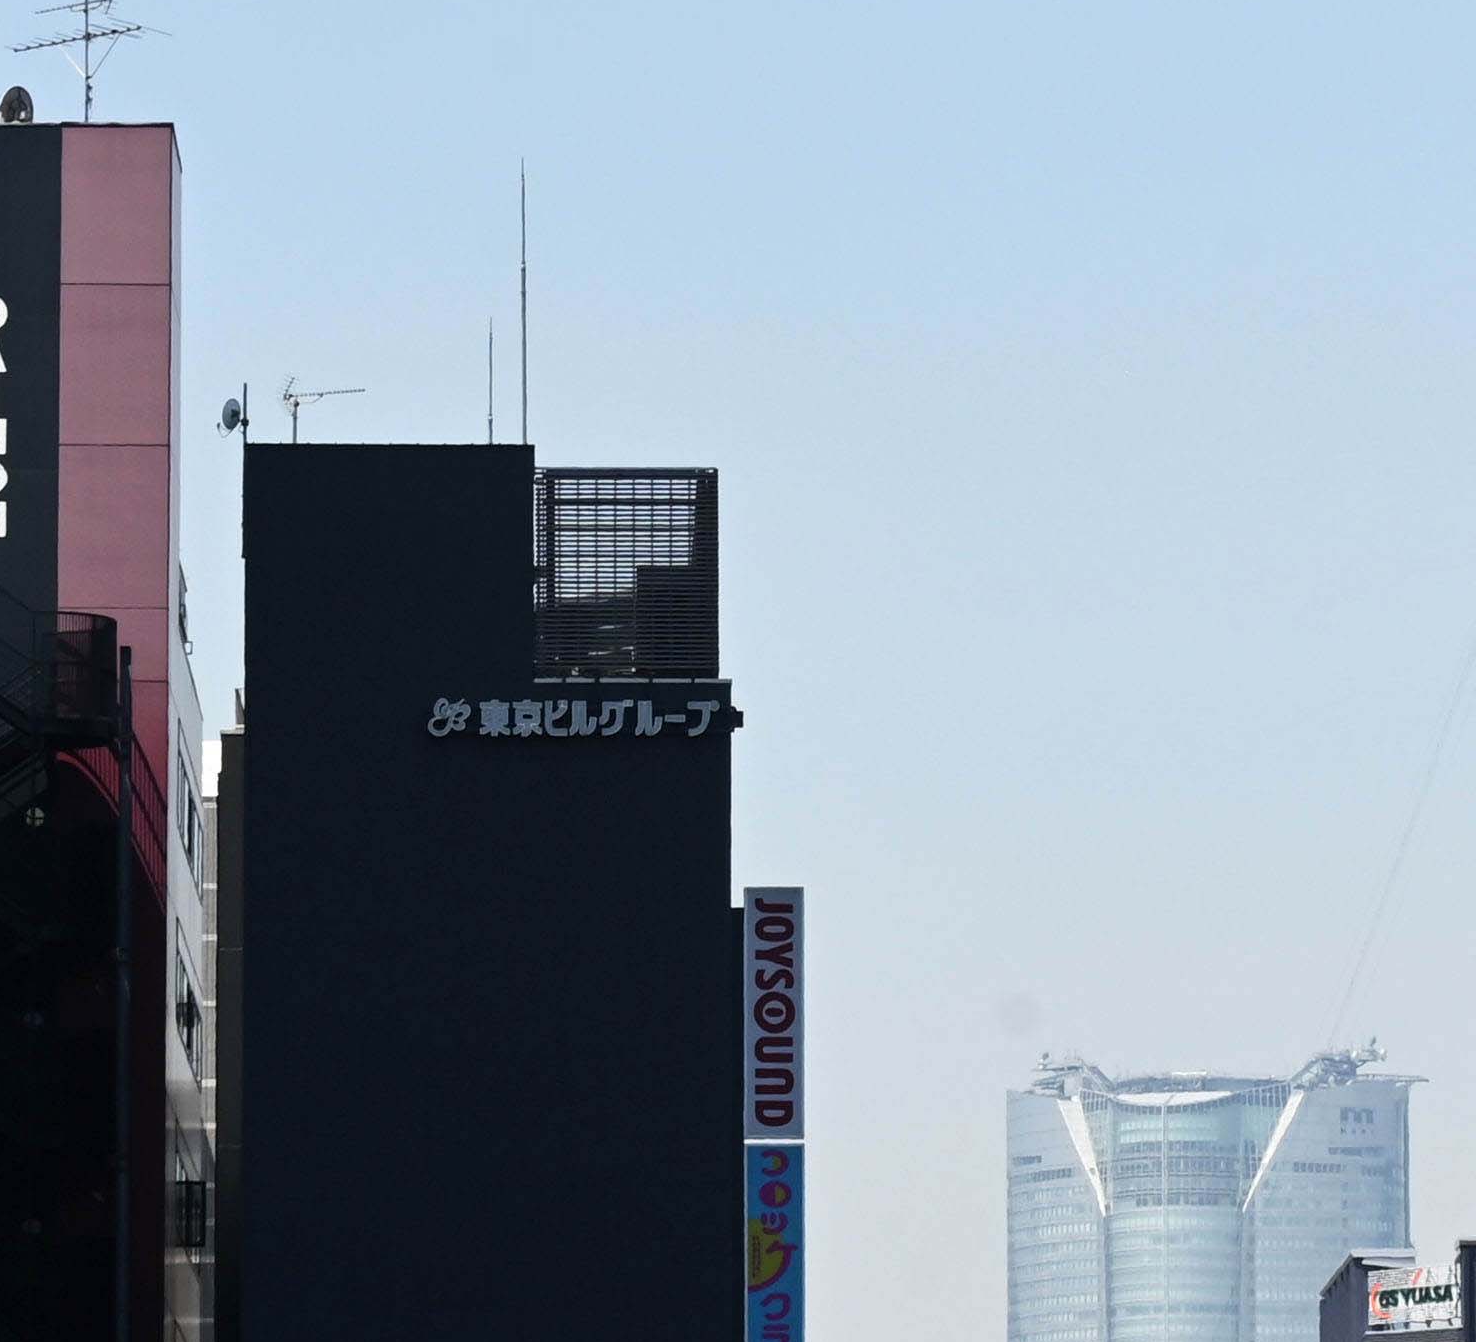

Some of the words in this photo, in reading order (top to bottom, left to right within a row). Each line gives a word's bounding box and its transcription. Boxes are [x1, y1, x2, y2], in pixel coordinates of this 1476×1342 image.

[479, 699, 720, 737] 東京ビルグループ
[754, 898, 795, 1128] JOYSOUND
